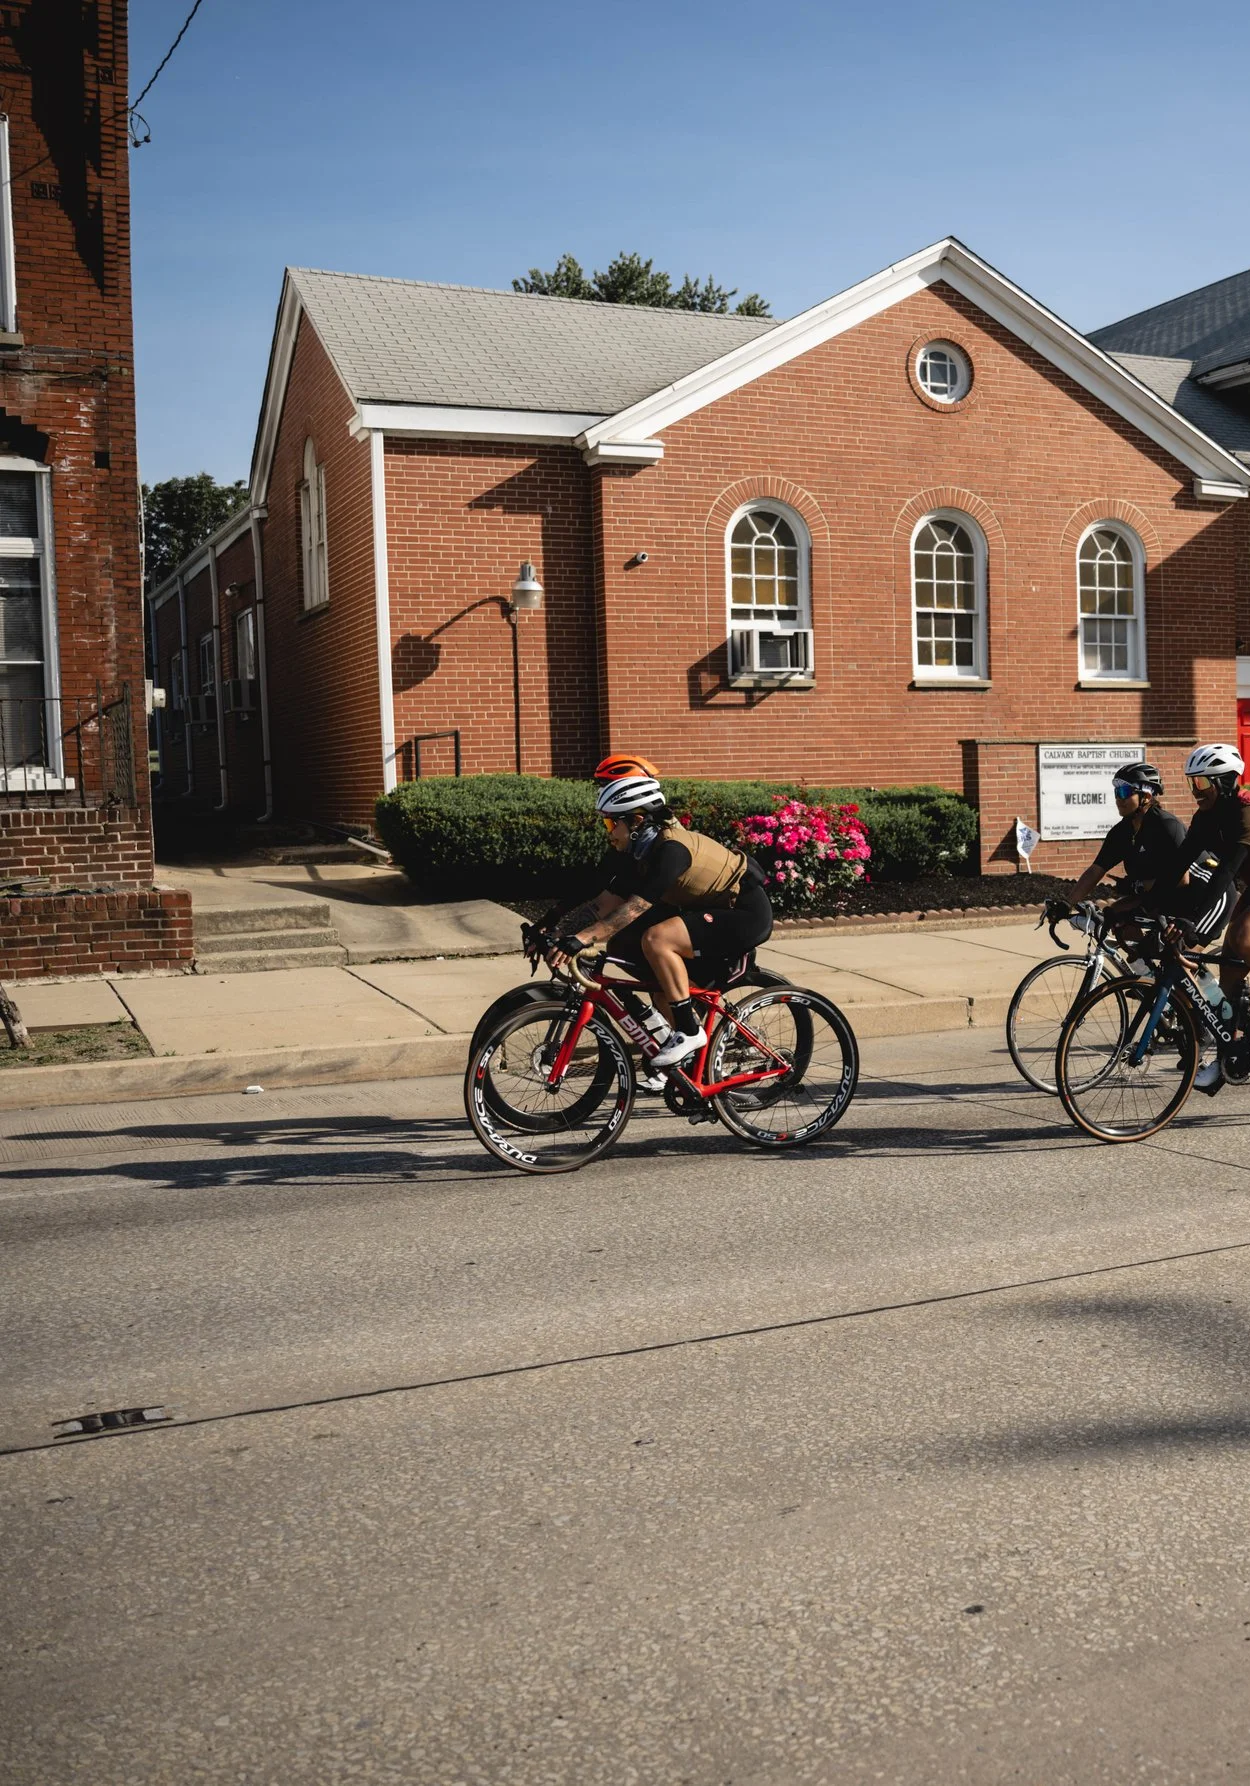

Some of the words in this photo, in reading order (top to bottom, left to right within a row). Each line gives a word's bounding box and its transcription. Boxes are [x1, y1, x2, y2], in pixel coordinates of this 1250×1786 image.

[1044, 750, 1074, 759] CALVARY
[1077, 750, 1107, 759] BAPTIST
[1109, 750, 1139, 758] CHURCH
[1064, 793, 1106, 805] WELCOME!
[780, 995, 812, 1006] C50
[1180, 977, 1232, 1042] PINARELLO
[619, 1014, 655, 1057] BMC
[476, 1045, 494, 1080] C50
[608, 1099, 625, 1131] C50
[794, 1065, 852, 1139] DURA-ACE
[474, 1086, 538, 1164] DURA-ACE
[756, 1130, 788, 1141] C50
